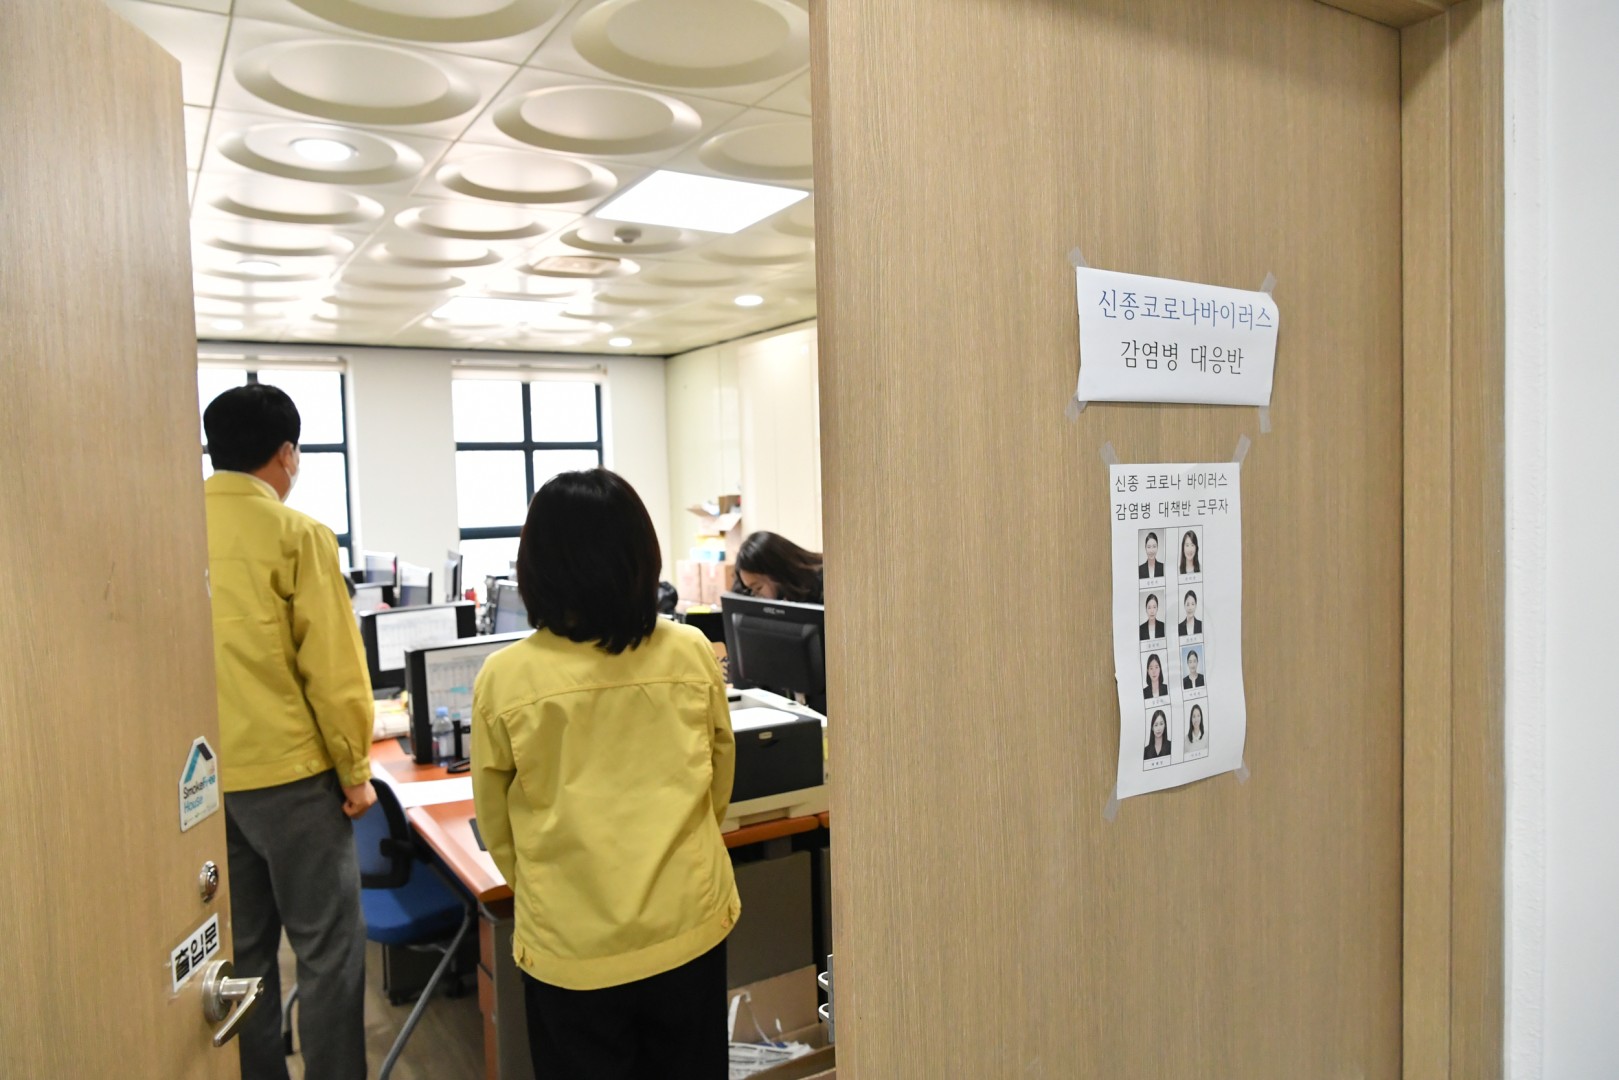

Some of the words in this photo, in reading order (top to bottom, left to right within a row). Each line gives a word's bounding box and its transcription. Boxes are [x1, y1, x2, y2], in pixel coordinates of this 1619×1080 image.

[1098, 288, 1273, 331] 신종코로나바이러스
[1120, 339, 1179, 371] 감염병
[1190, 345, 1245, 375] 대응반
[1115, 474, 1139, 493] 신종
[1145, 473, 1181, 490] 코로나
[1187, 472, 1228, 489] 바이러스
[1115, 501, 1151, 521] 감염병
[1158, 499, 1192, 518] 대책반
[1196, 498, 1229, 516] 근무자
[183, 796, 204, 814] House
[174, 921, 217, 983] 출입문
